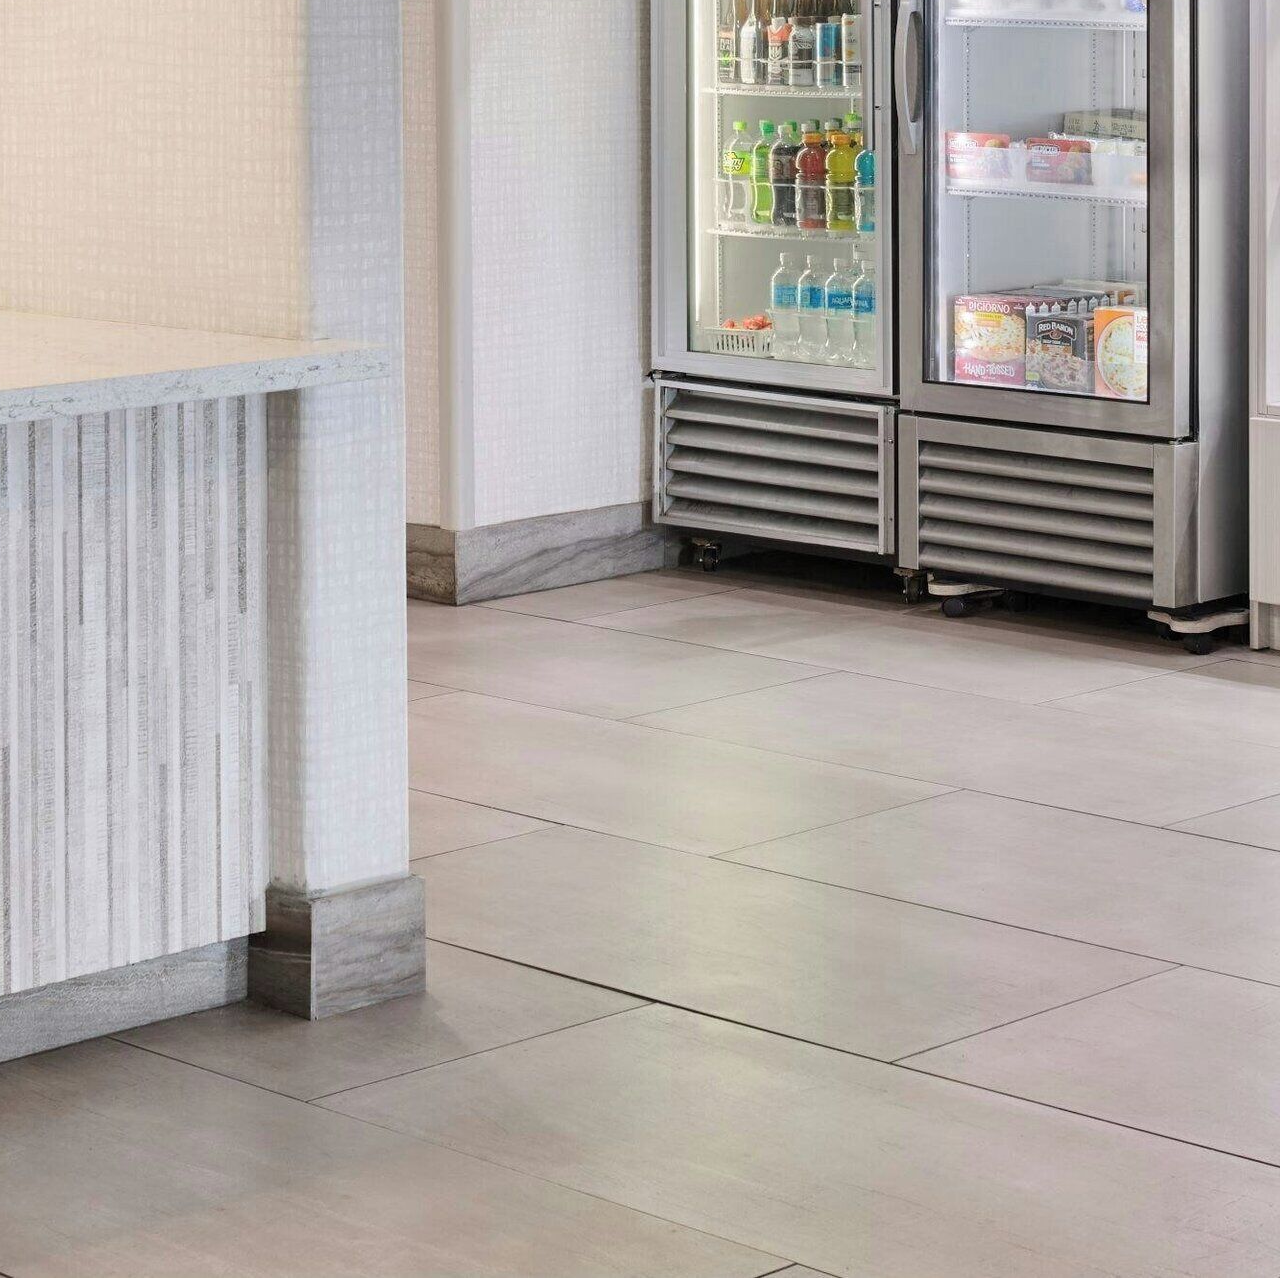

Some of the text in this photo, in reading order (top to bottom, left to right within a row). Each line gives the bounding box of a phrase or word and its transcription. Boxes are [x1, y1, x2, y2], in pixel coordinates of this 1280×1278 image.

[969, 301, 1010, 314] DIGIORNO
[1038, 322, 1074, 335] RED BARON
